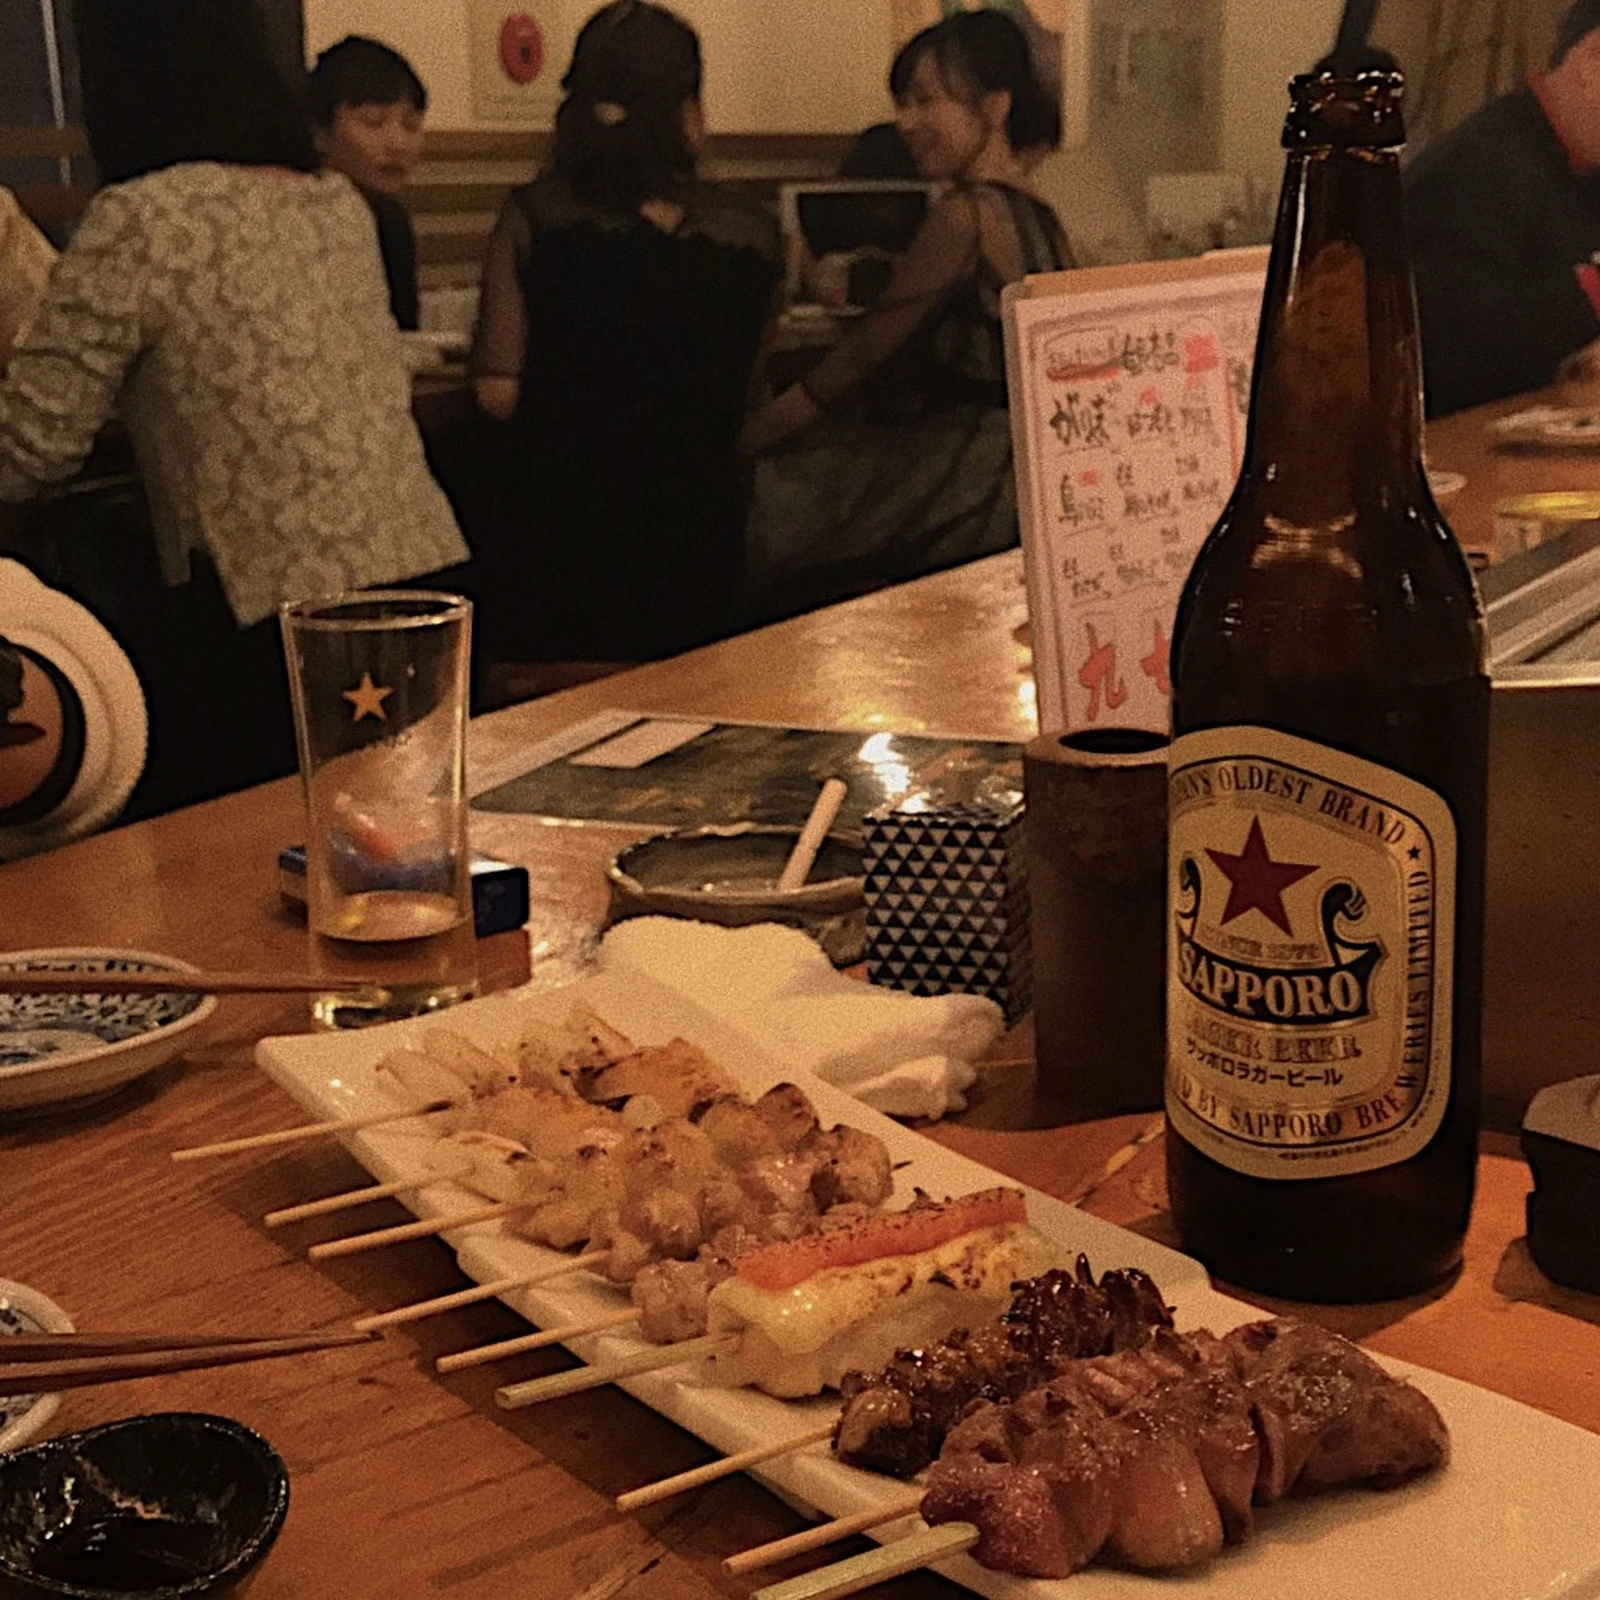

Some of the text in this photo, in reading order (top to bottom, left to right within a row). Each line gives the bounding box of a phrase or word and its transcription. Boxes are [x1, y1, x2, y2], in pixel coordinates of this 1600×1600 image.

[1218, 766, 1313, 804] OLDEST
[1319, 789, 1405, 843] BRAND
[1180, 941, 1362, 1018] SAPPORO
[1229, 1107, 1342, 1138] SAPPORO
[1407, 871, 1430, 980] LIMITED
